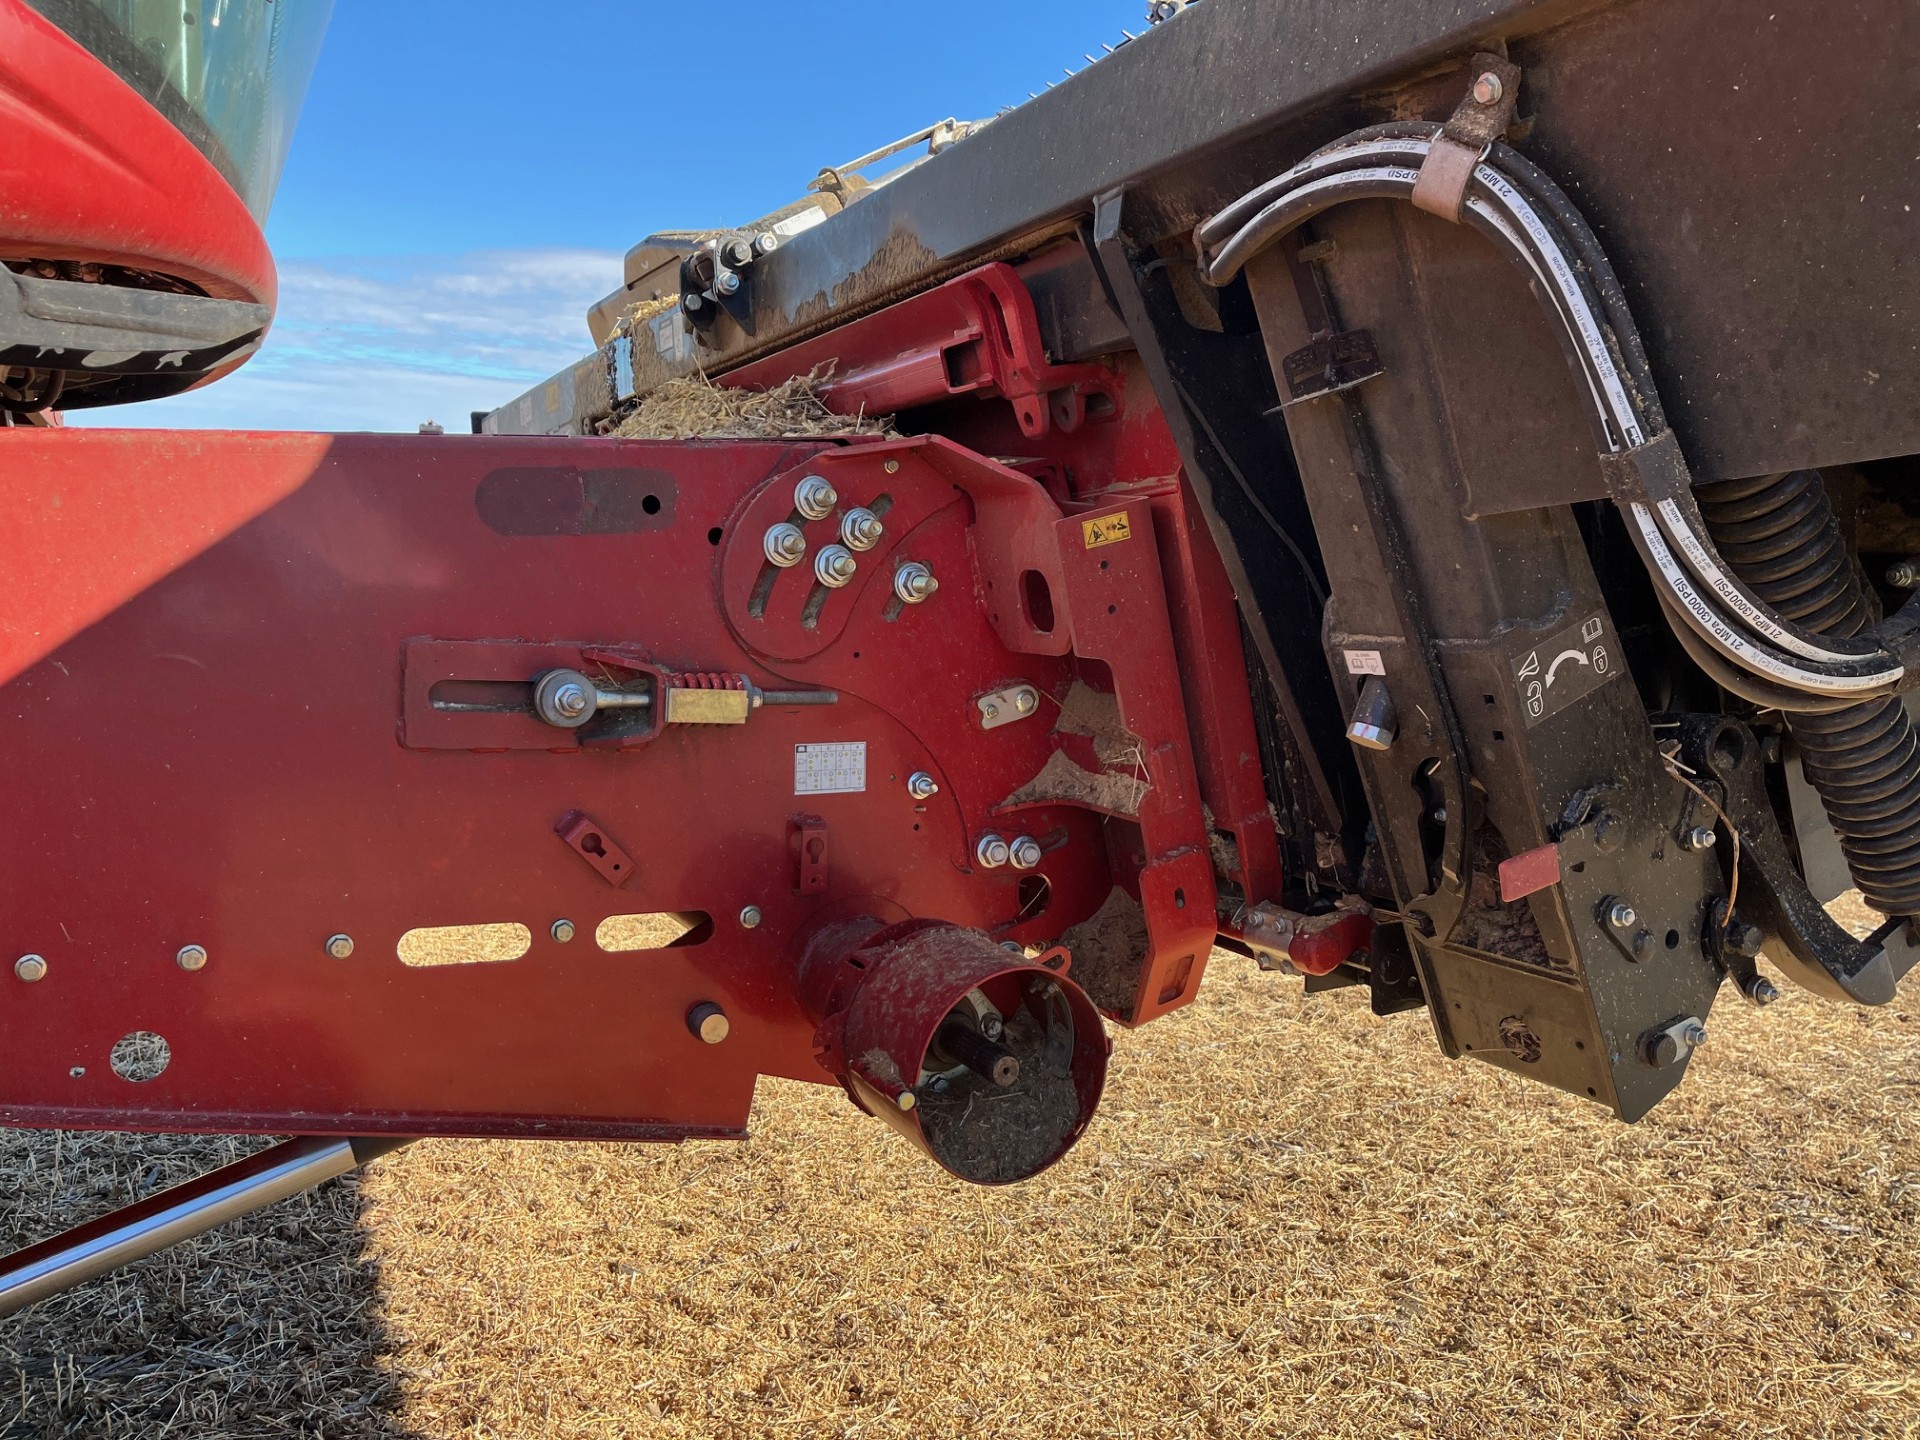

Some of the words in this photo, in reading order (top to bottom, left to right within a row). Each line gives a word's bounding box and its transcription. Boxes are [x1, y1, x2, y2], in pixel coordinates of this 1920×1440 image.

[1477, 166, 1500, 186] MPa
[1497, 184, 1512, 197] 21
[1562, 277, 1576, 297] MSHA
[1606, 365, 1614, 377] ISO
[1670, 507, 1681, 523] MADE
[1672, 576, 1692, 600] PSI)
[1714, 577, 1734, 598] PSI)
[1687, 595, 1713, 624] (3000
[1729, 593, 1755, 618] (3000
[1710, 620, 1732, 642] MPa
[1752, 614, 1772, 632] MPa
[1769, 628, 1782, 639] 21
[1730, 638, 1744, 650] 21
